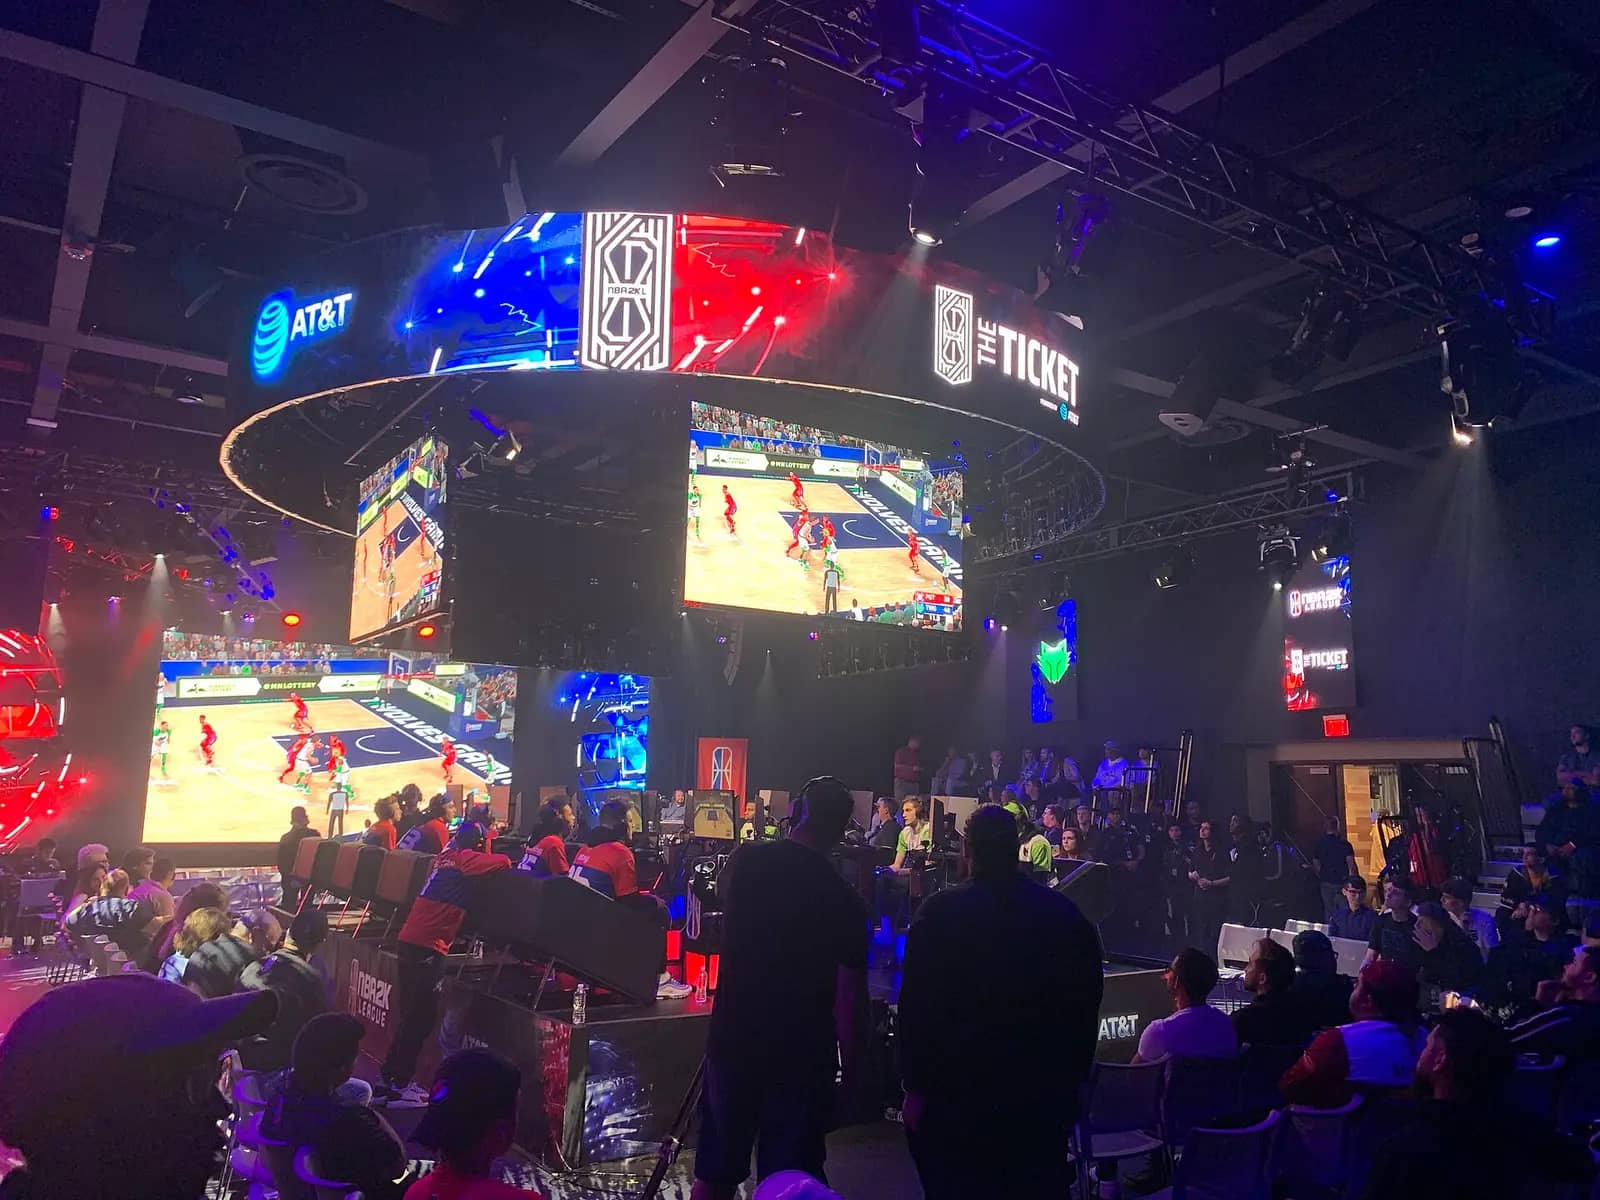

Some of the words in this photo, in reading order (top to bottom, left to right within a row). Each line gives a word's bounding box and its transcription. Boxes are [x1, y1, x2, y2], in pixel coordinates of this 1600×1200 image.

[289, 293, 353, 341] AT&T
[977, 316, 997, 365] THE
[998, 325, 1080, 407] TICKET
[1311, 649, 1348, 668] TICKET
[358, 1000, 387, 1028] LEAGUE
[1097, 1014, 1139, 1041] AT&T
